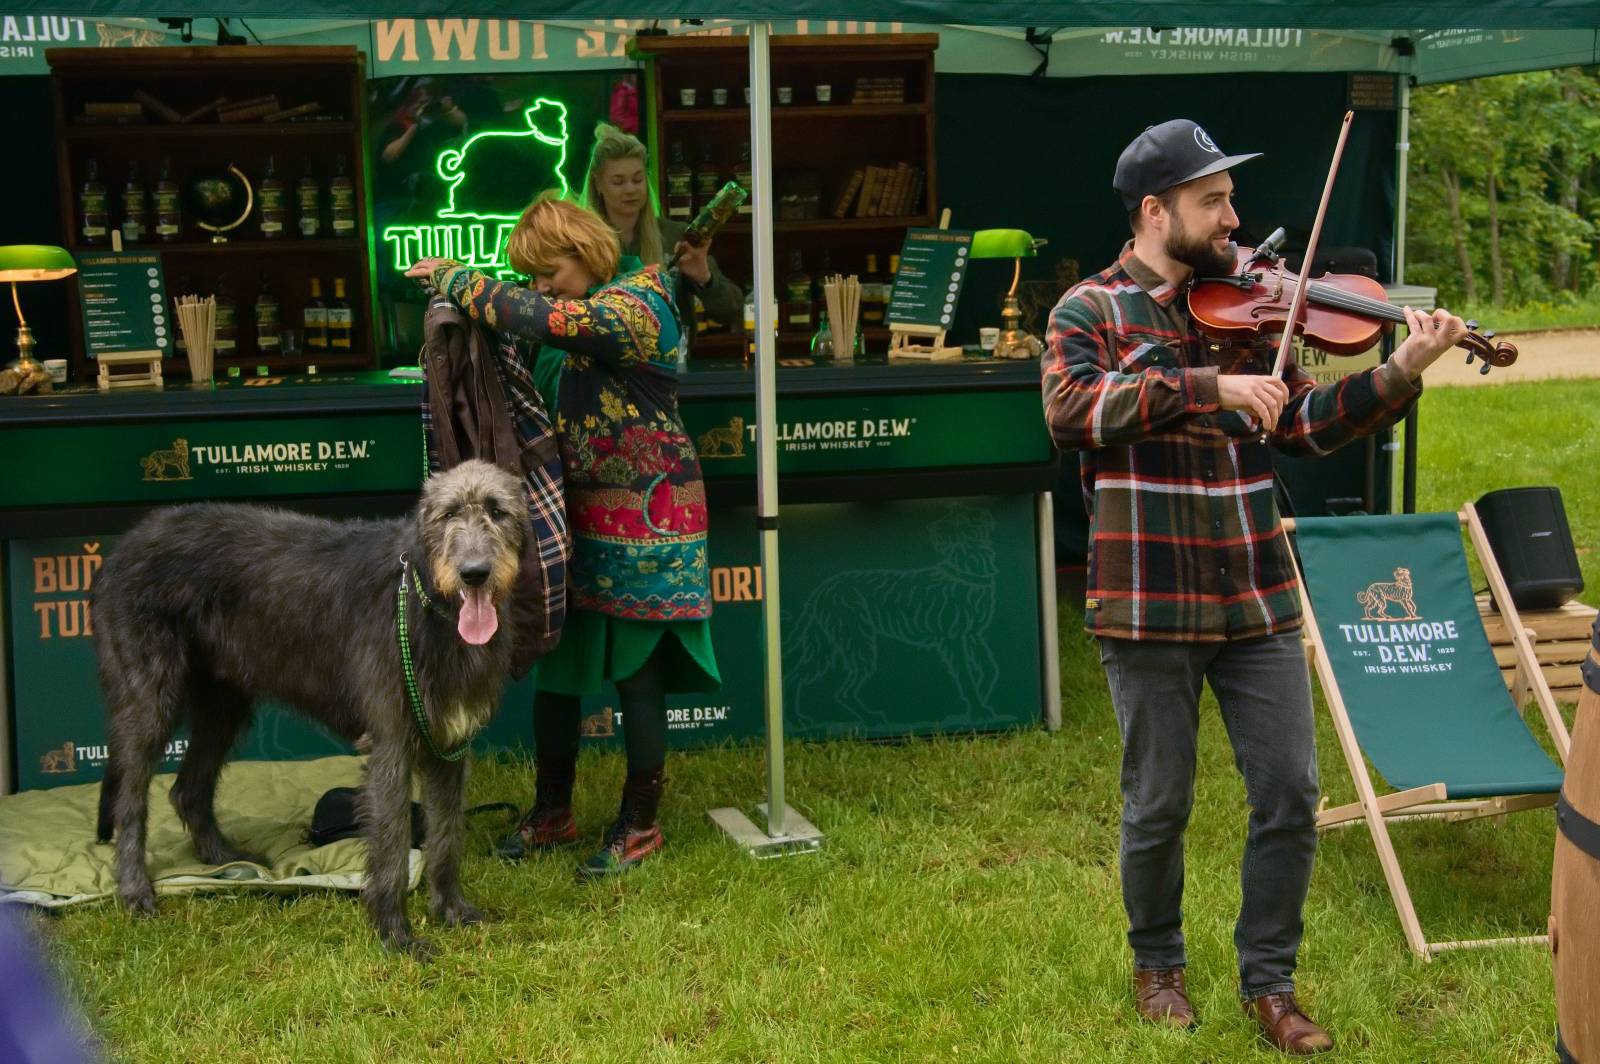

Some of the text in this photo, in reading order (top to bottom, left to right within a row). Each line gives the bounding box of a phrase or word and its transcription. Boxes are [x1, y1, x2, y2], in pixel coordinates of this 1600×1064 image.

[746, 418, 911, 442] TLLAMORE D.E.W.
[192, 440, 370, 464] TULLAMORE D.E.W.
[785, 442, 816, 451] IRISH
[820, 440, 871, 450] WHISKEY
[237, 465, 269, 474] IRISH
[274, 462, 328, 473] WHISKEY
[1338, 620, 1459, 643] TULLAMORE
[1378, 644, 1432, 664] D.E.W.
[1364, 663, 1453, 674] IRISH WHISKEY
[694, 707, 727, 721] D.E.W.
